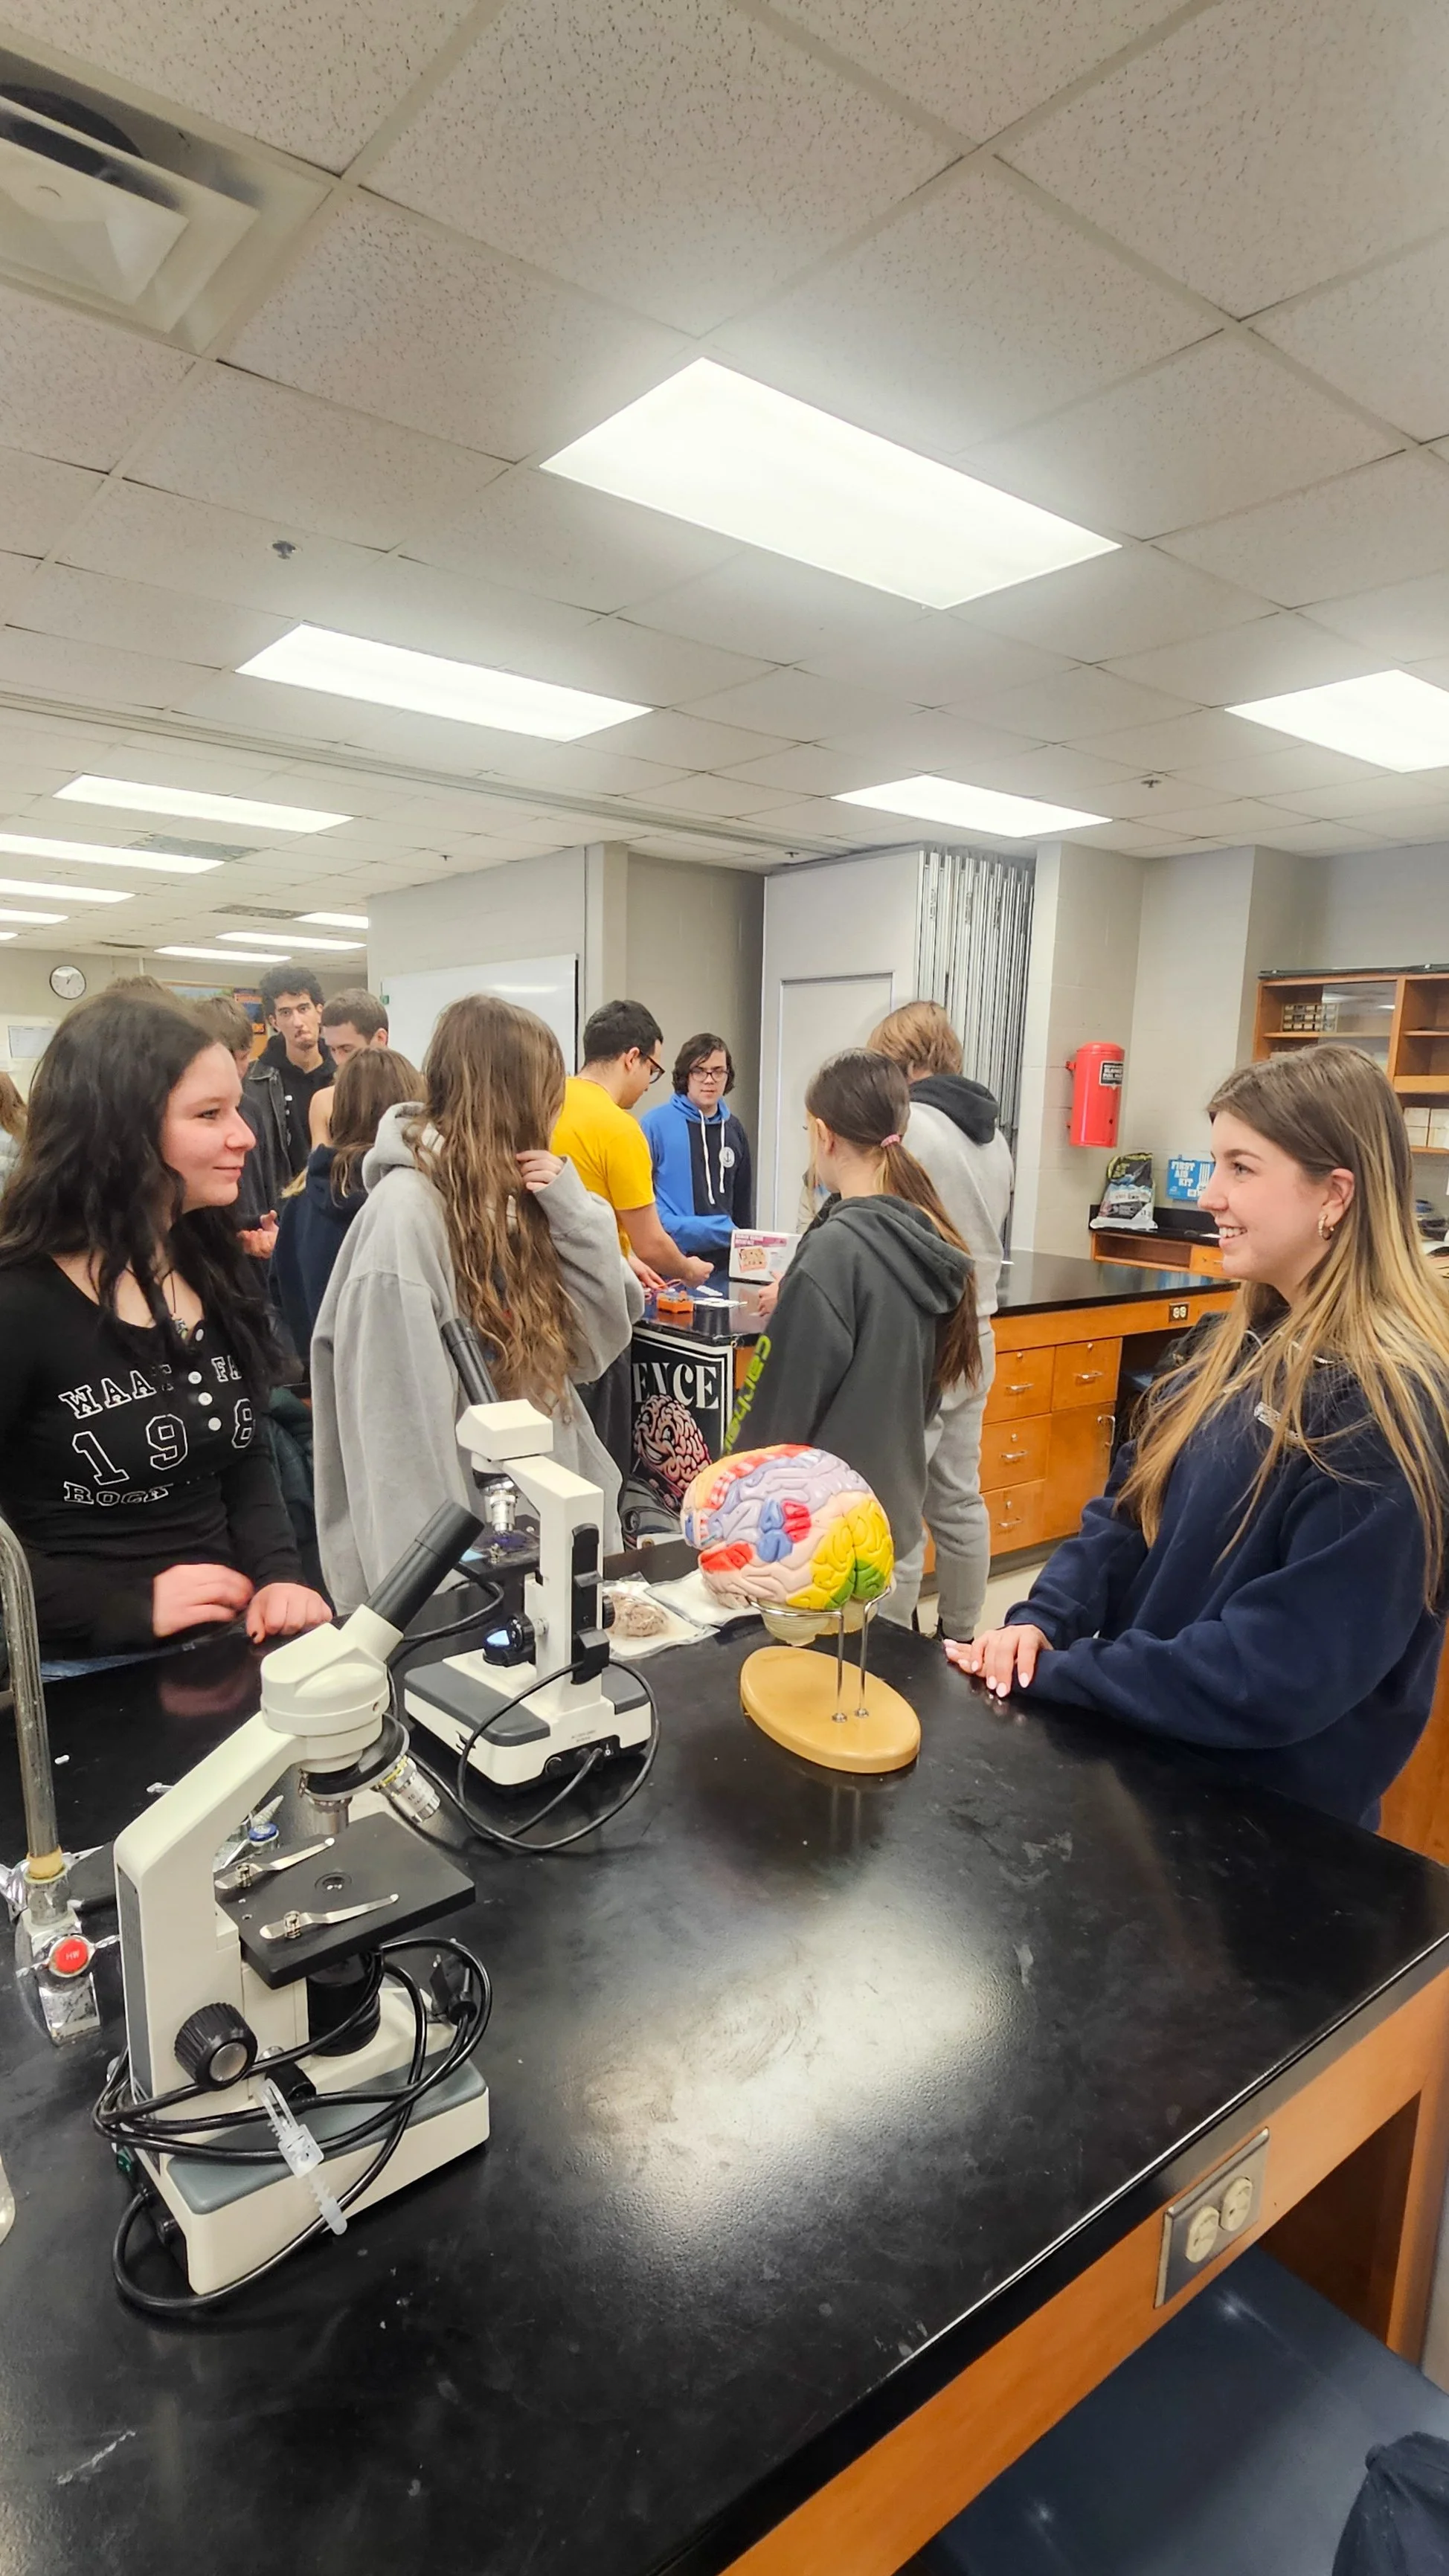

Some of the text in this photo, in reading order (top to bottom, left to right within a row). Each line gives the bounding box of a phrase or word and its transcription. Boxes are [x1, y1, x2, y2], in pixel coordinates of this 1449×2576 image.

[1172, 1162, 1195, 1171] FIRST
[1175, 1170, 1189, 1178] AID
[1178, 1178, 1194, 1186] KIT
[632, 1362, 719, 1409] ENCE
[65, 1949, 80, 1960] HW
